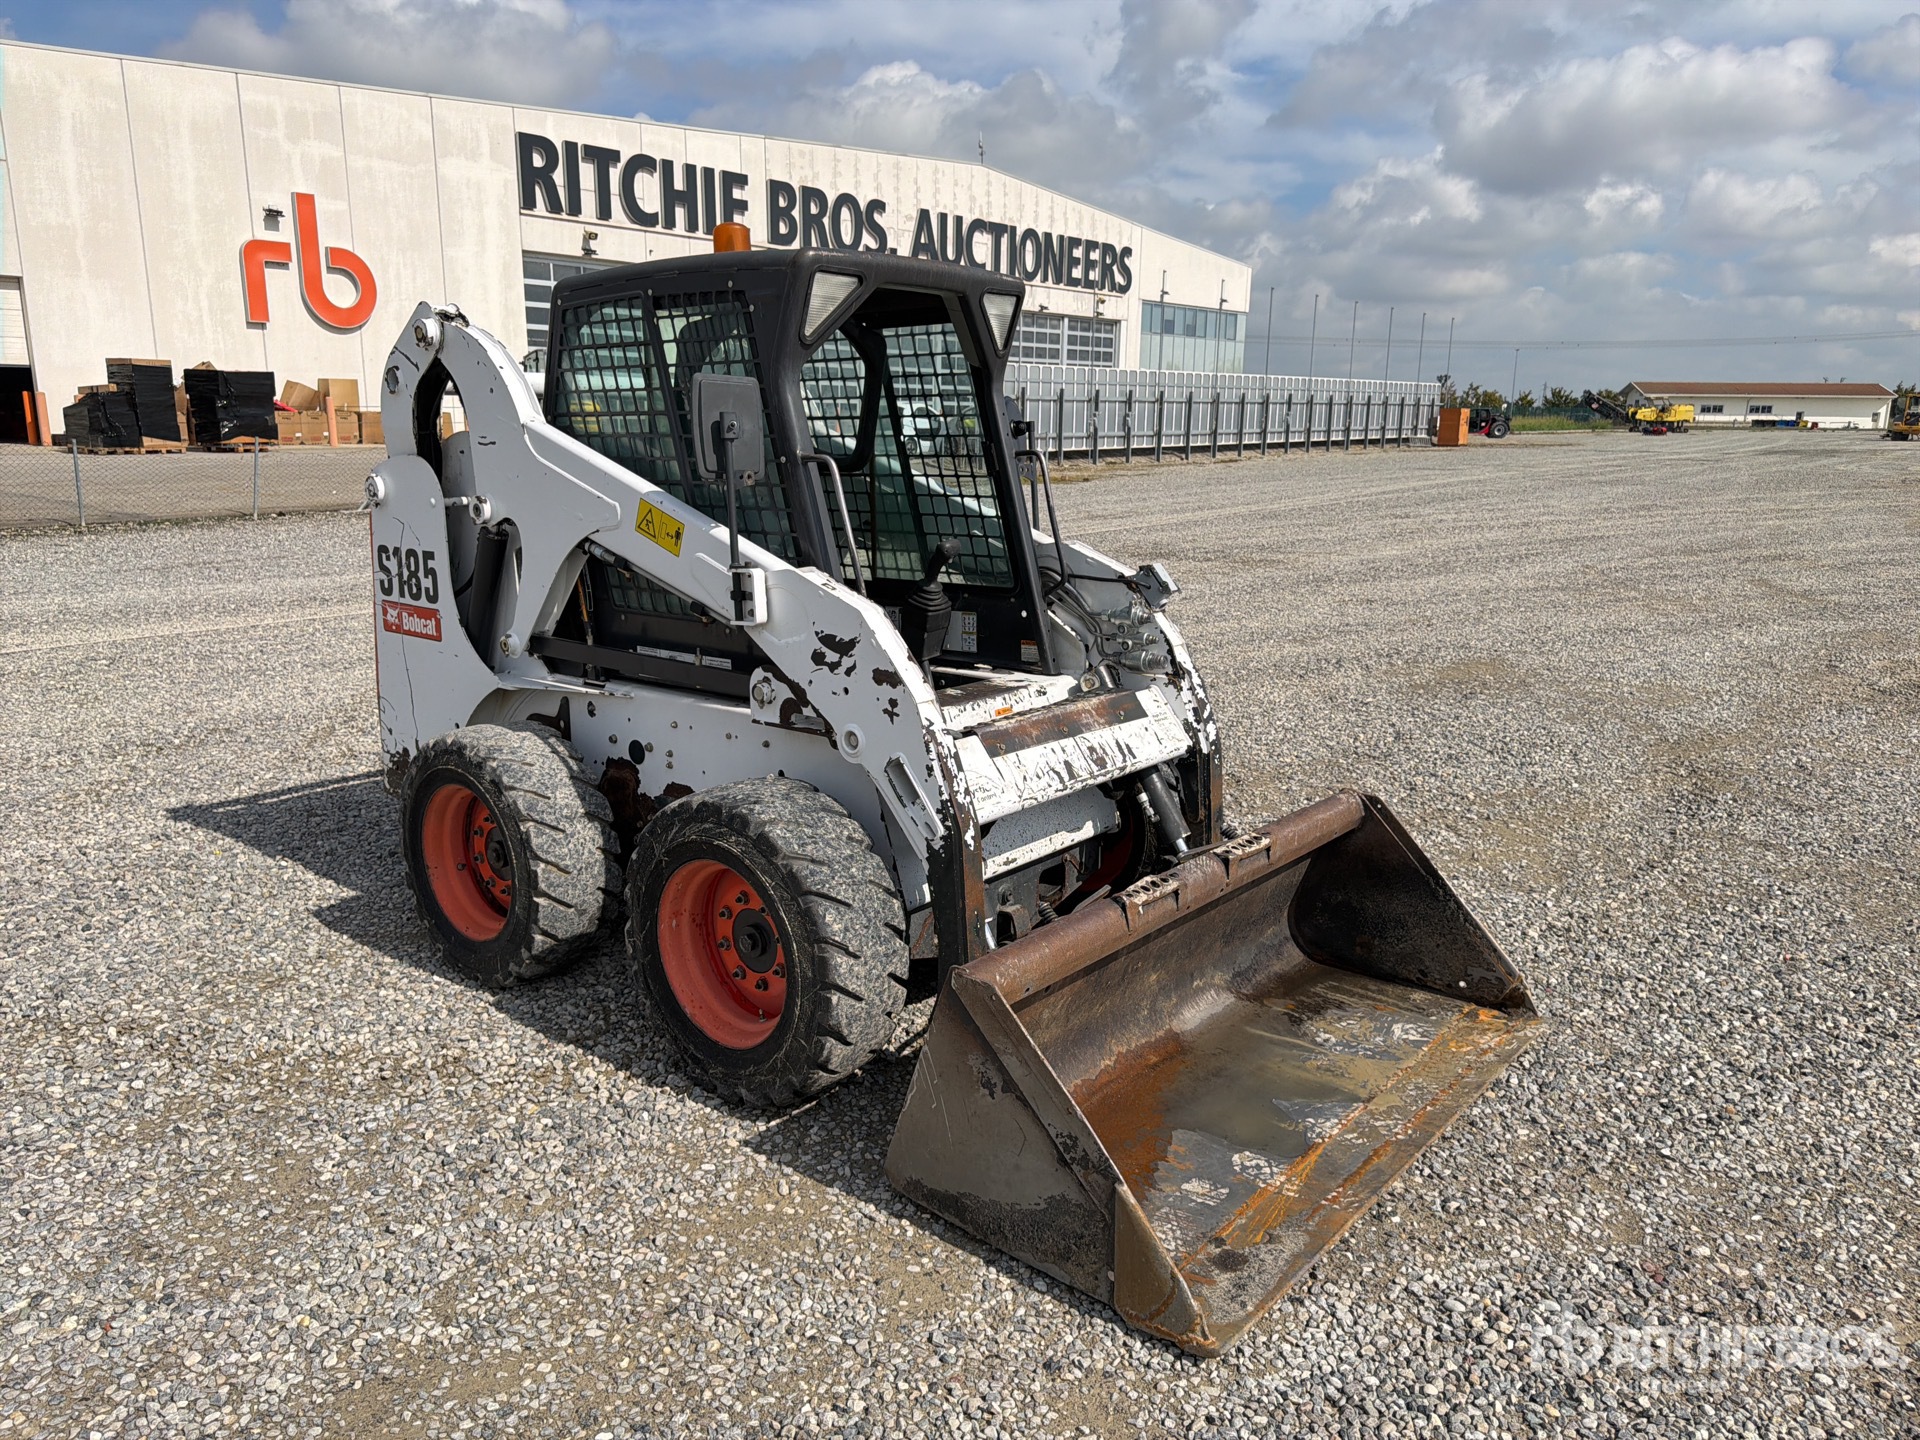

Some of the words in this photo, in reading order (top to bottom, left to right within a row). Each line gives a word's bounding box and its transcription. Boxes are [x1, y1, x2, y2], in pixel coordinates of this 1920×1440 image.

[239, 191, 378, 329] rb
[515, 131, 749, 236] RITCHIE
[909, 208, 1133, 295] AUCTIONEERS
[377, 544, 439, 605] S185
[402, 611, 437, 637] Bobcat
